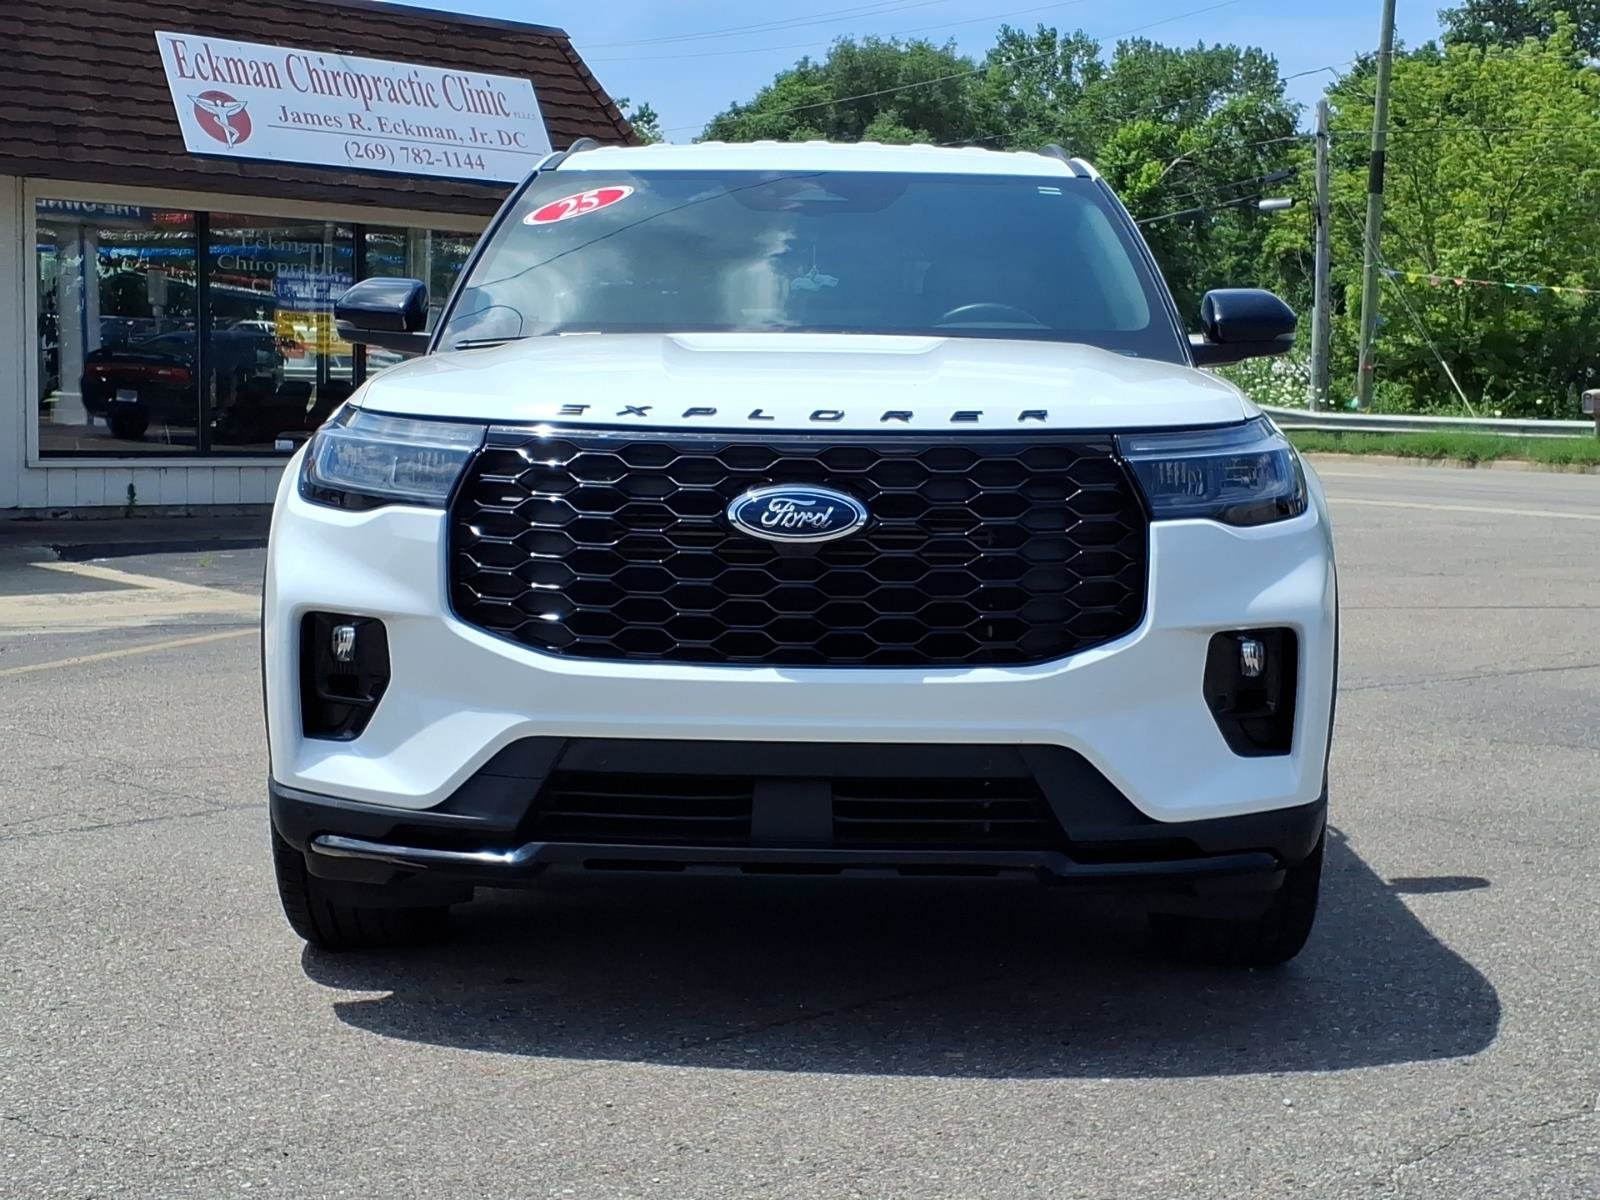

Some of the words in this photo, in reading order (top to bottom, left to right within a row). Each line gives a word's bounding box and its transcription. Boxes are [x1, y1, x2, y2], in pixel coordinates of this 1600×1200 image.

[169, 38, 282, 90] Eckman
[285, 53, 440, 112] Chiropractic
[442, 73, 511, 118] Clinic
[278, 105, 343, 130] James
[349, 114, 372, 132] R.
[378, 116, 463, 145] Eckman,
[468, 126, 493, 147] Jr.
[499, 129, 529, 149] DC
[344, 140, 395, 164] (269)
[400, 144, 486, 171] 782-1144
[556, 403, 1048, 424] EXPLORER
[761, 498, 834, 528] Ford
